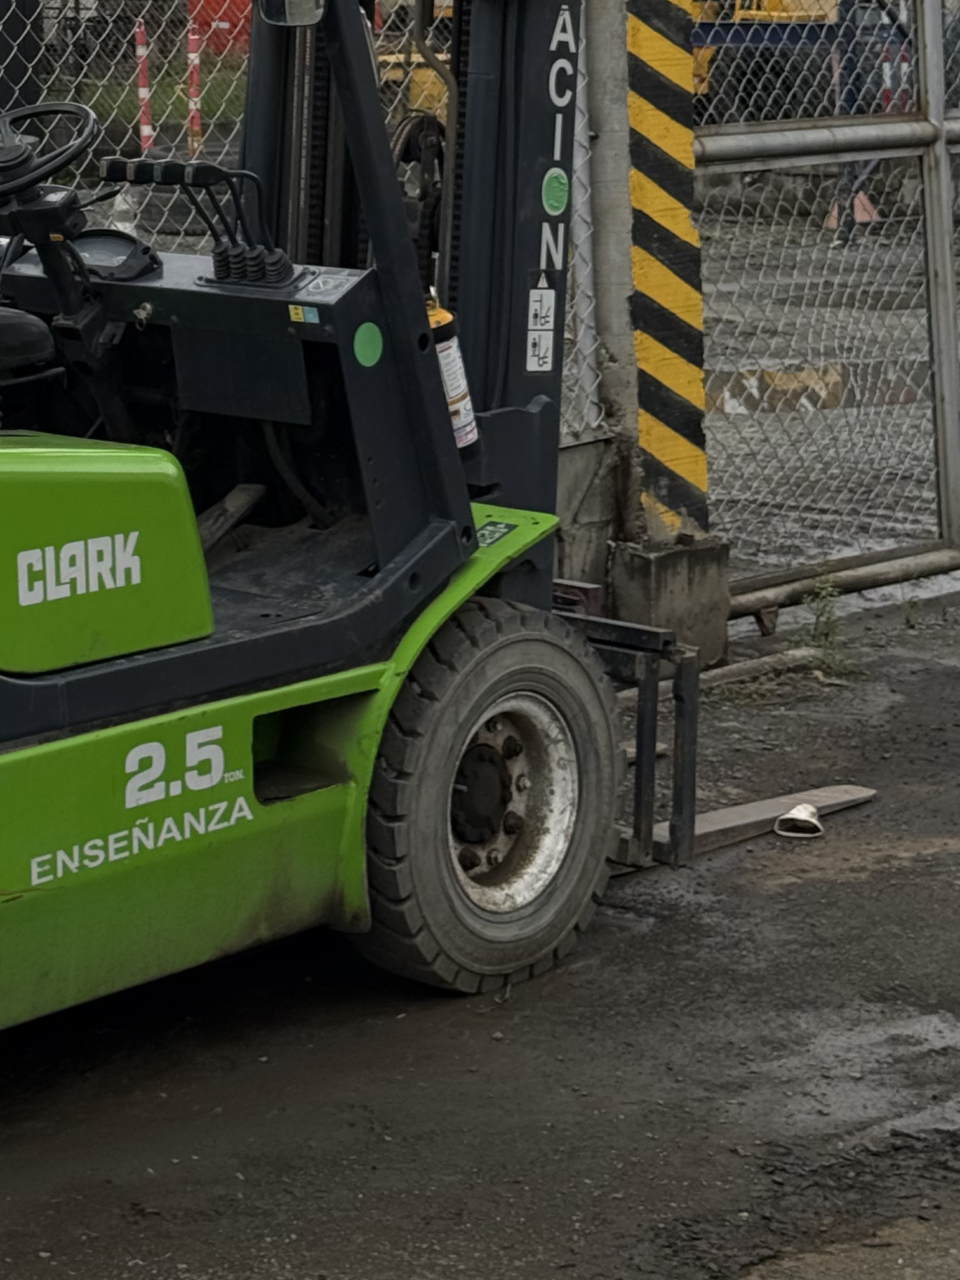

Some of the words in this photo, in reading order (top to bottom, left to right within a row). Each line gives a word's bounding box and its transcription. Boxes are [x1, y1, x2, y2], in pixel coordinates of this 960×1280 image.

[16, 530, 142, 607] CLARK
[125, 725, 225, 809] 2.5
[30, 796, 254, 886] ENSEÑANZA
